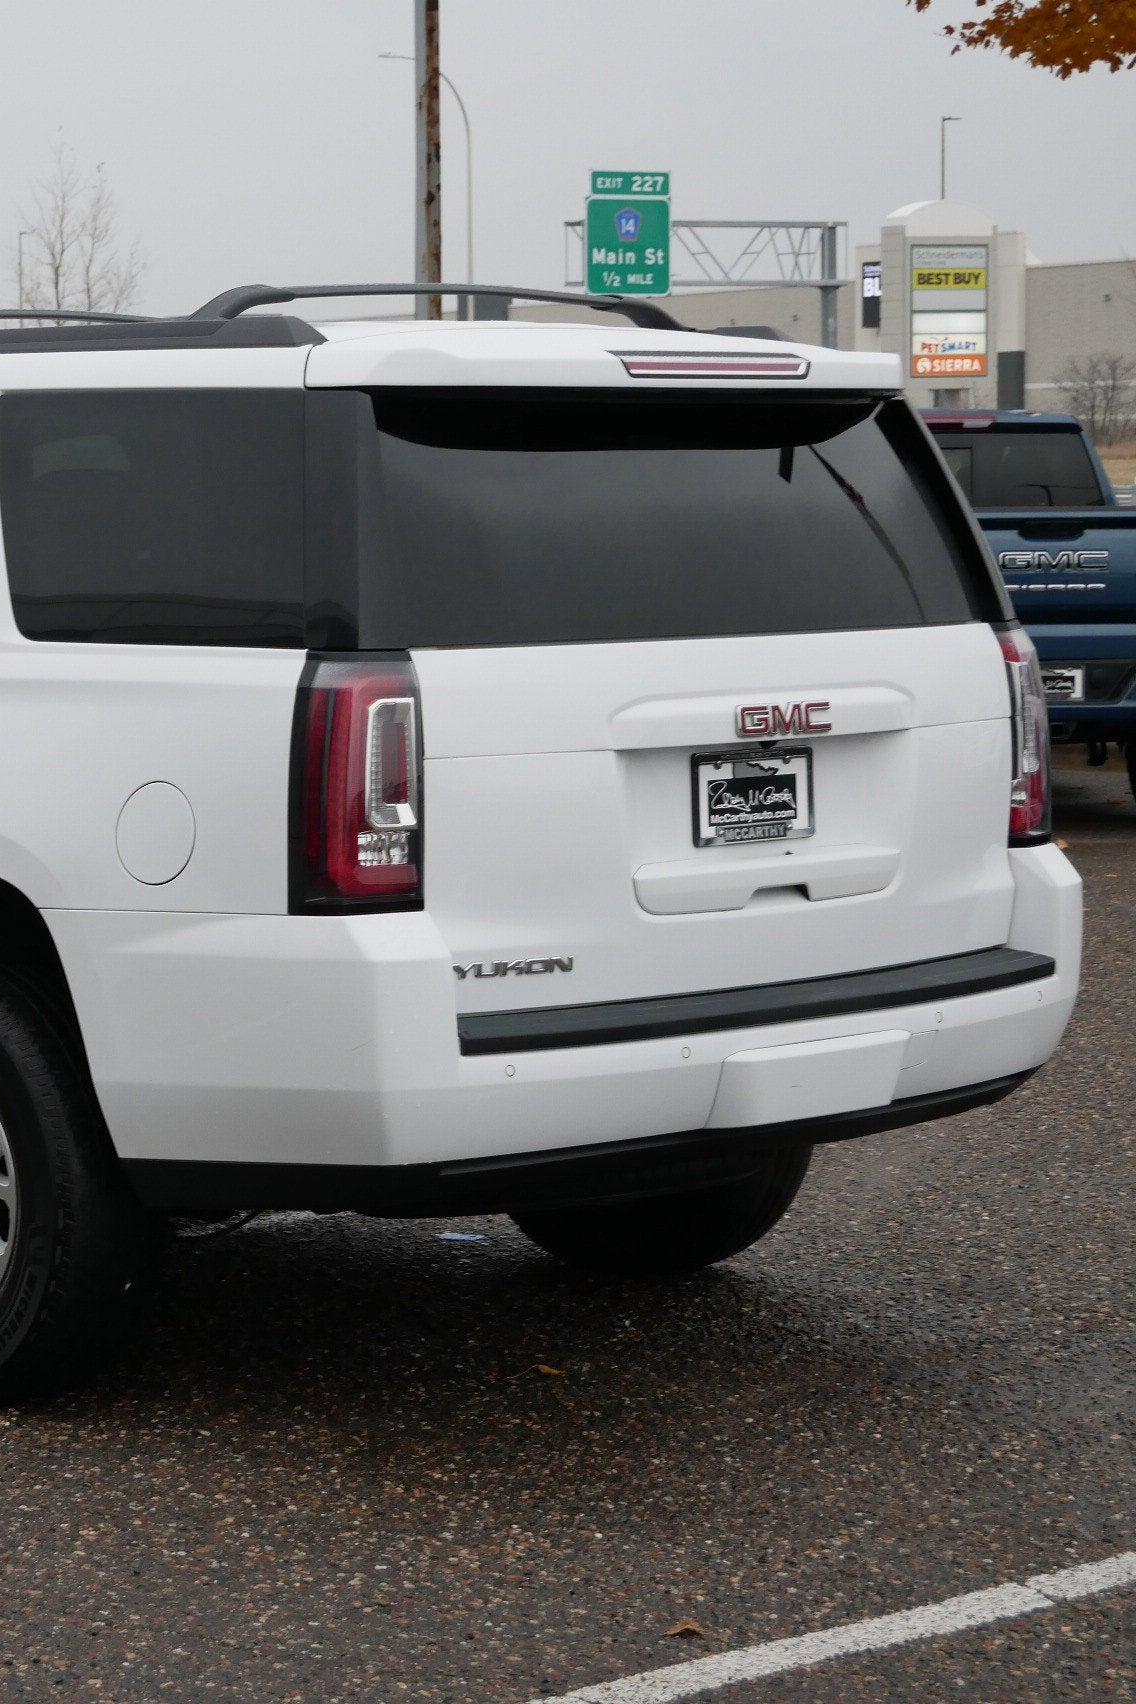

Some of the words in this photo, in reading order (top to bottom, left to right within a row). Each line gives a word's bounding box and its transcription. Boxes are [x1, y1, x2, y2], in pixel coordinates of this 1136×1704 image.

[596, 177, 624, 189] EXIT
[630, 175, 665, 192] 227
[620, 218, 636, 234] 14
[592, 248, 637, 265] Main
[644, 248, 665, 265] St
[627, 273, 654, 285] MILE
[917, 272, 952, 285] BEST
[954, 271, 982, 285] BUY
[932, 358, 982, 372] SIERRA
[998, 550, 1109, 571] GMC
[737, 702, 831, 737] GMC
[451, 955, 574, 980] YUKON
